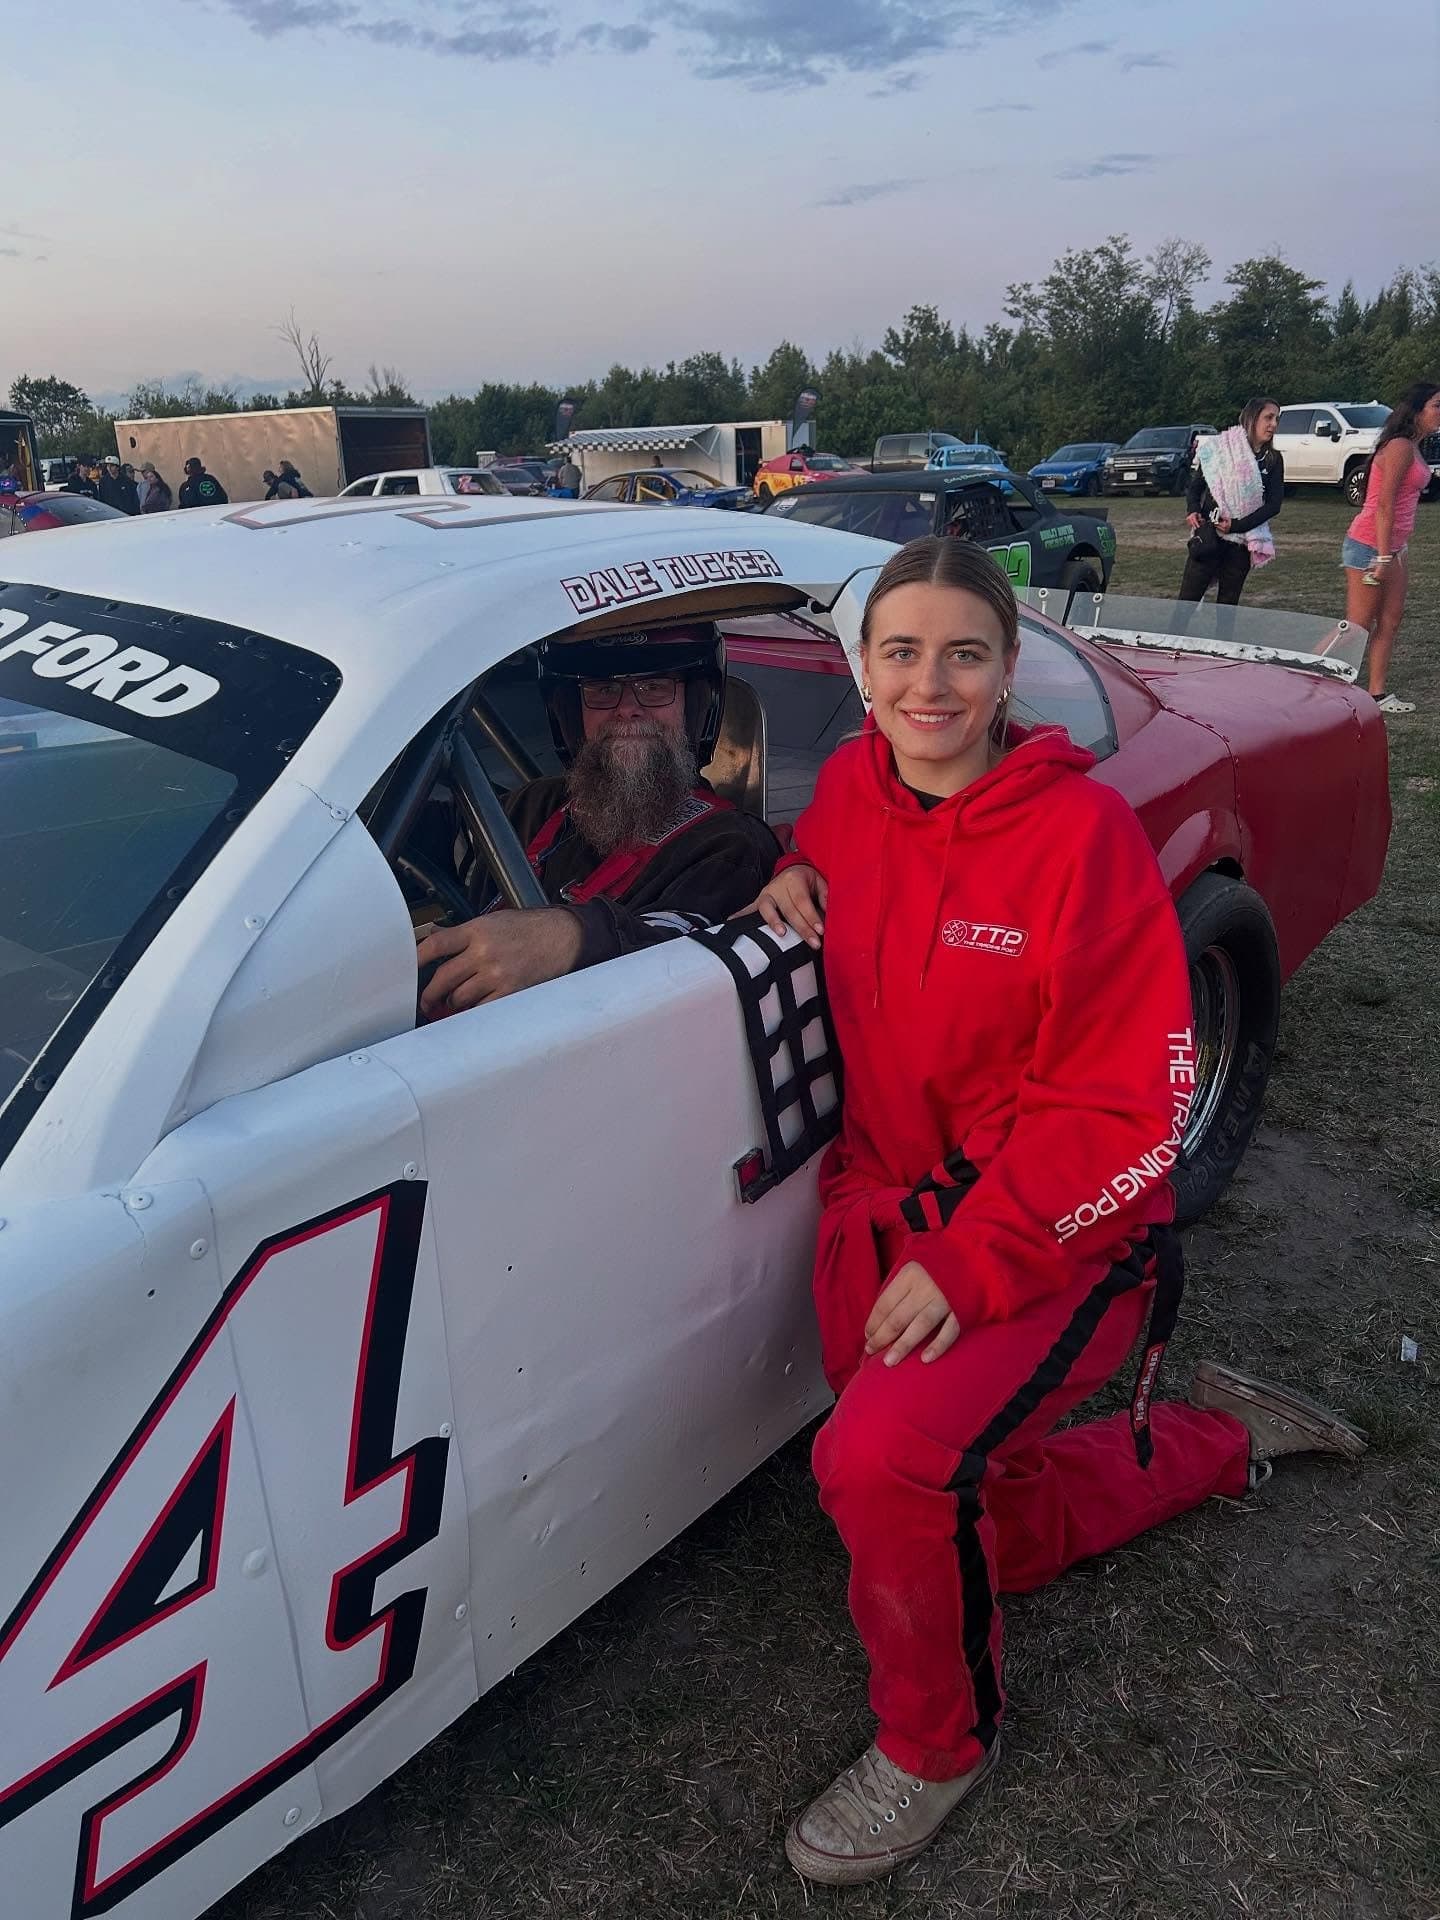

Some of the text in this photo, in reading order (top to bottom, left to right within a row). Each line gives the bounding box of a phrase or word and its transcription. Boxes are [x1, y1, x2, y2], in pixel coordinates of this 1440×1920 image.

[560, 549, 784, 614] DALE TUCKER
[963, 939, 1017, 954] THE TRADING POST
[971, 926, 1023, 945] TTP
[1054, 1027, 1196, 1244] THE TRADING POS
